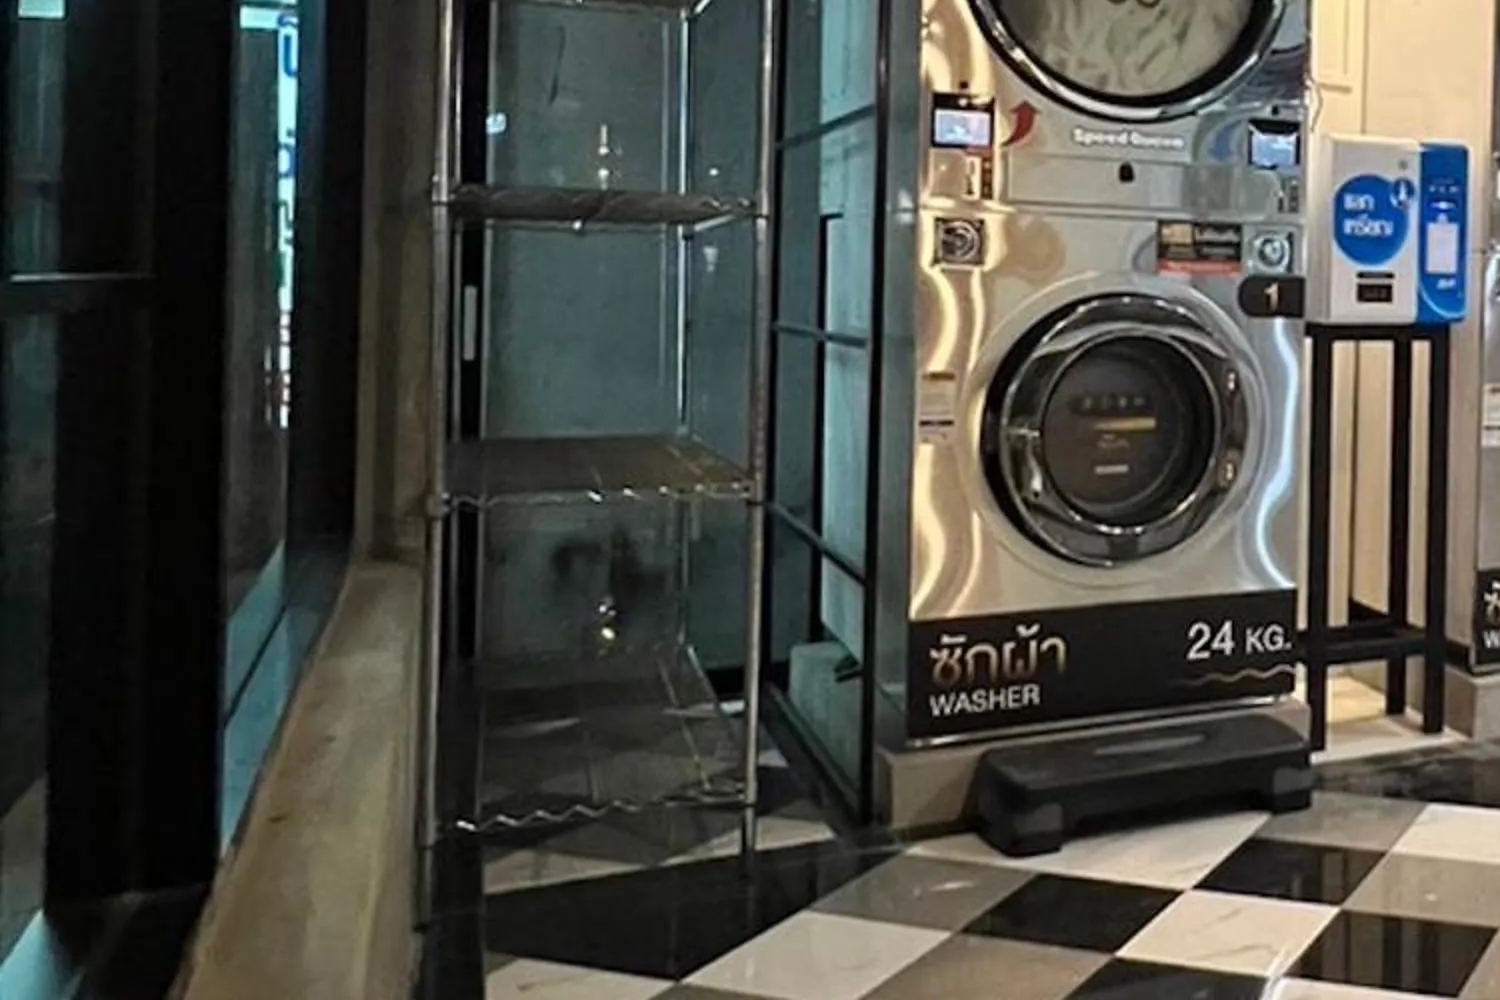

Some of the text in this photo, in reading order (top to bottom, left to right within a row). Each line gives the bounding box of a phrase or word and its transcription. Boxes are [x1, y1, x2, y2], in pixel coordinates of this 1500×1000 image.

[1263, 282, 1279, 310] 1
[929, 623, 1067, 686] ซักผ้า
[1186, 620, 1293, 661] 24 KG.
[929, 683, 1042, 716] WASHER
